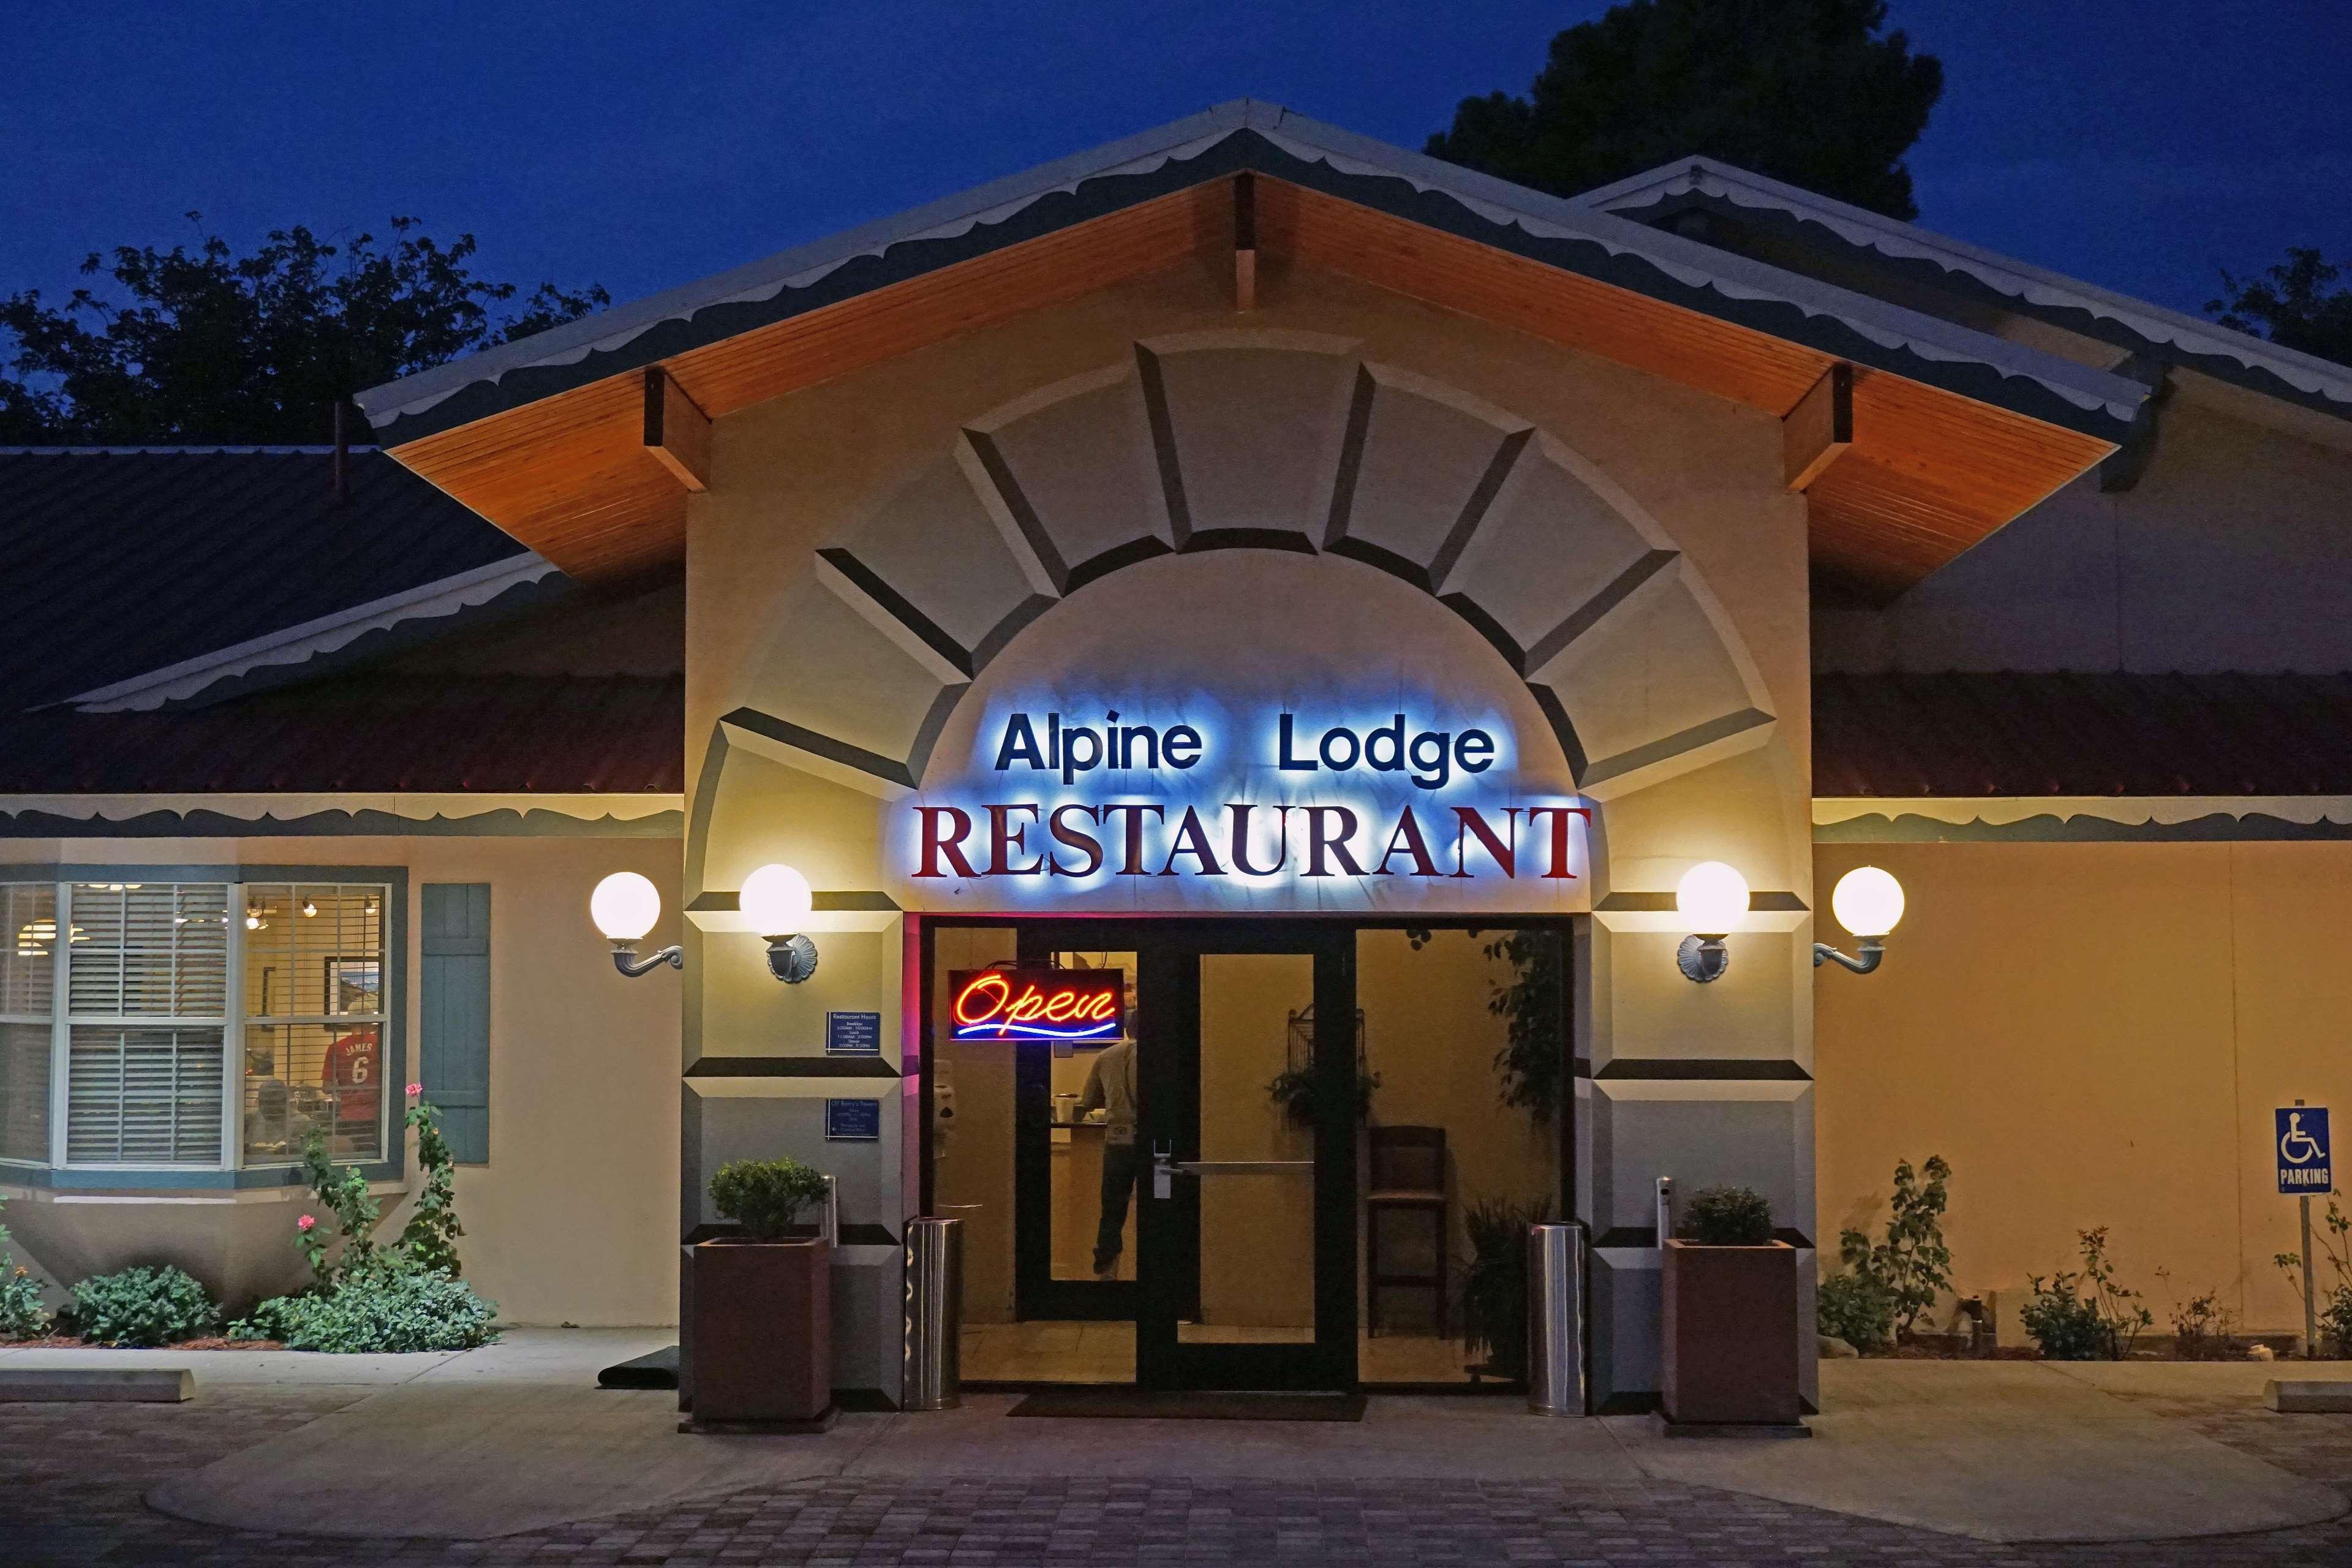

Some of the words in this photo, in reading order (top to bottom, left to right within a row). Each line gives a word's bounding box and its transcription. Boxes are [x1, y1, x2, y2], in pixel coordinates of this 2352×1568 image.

[995, 709, 1202, 785] Alpine
[1279, 714, 1495, 790] Lodge
[911, 804, 1592, 879] RESTAURANT
[957, 974, 1116, 1036] Open
[345, 1043, 372, 1056] JAMES
[352, 1057, 369, 1084] 6
[2280, 1168, 2329, 1185] PARKING
